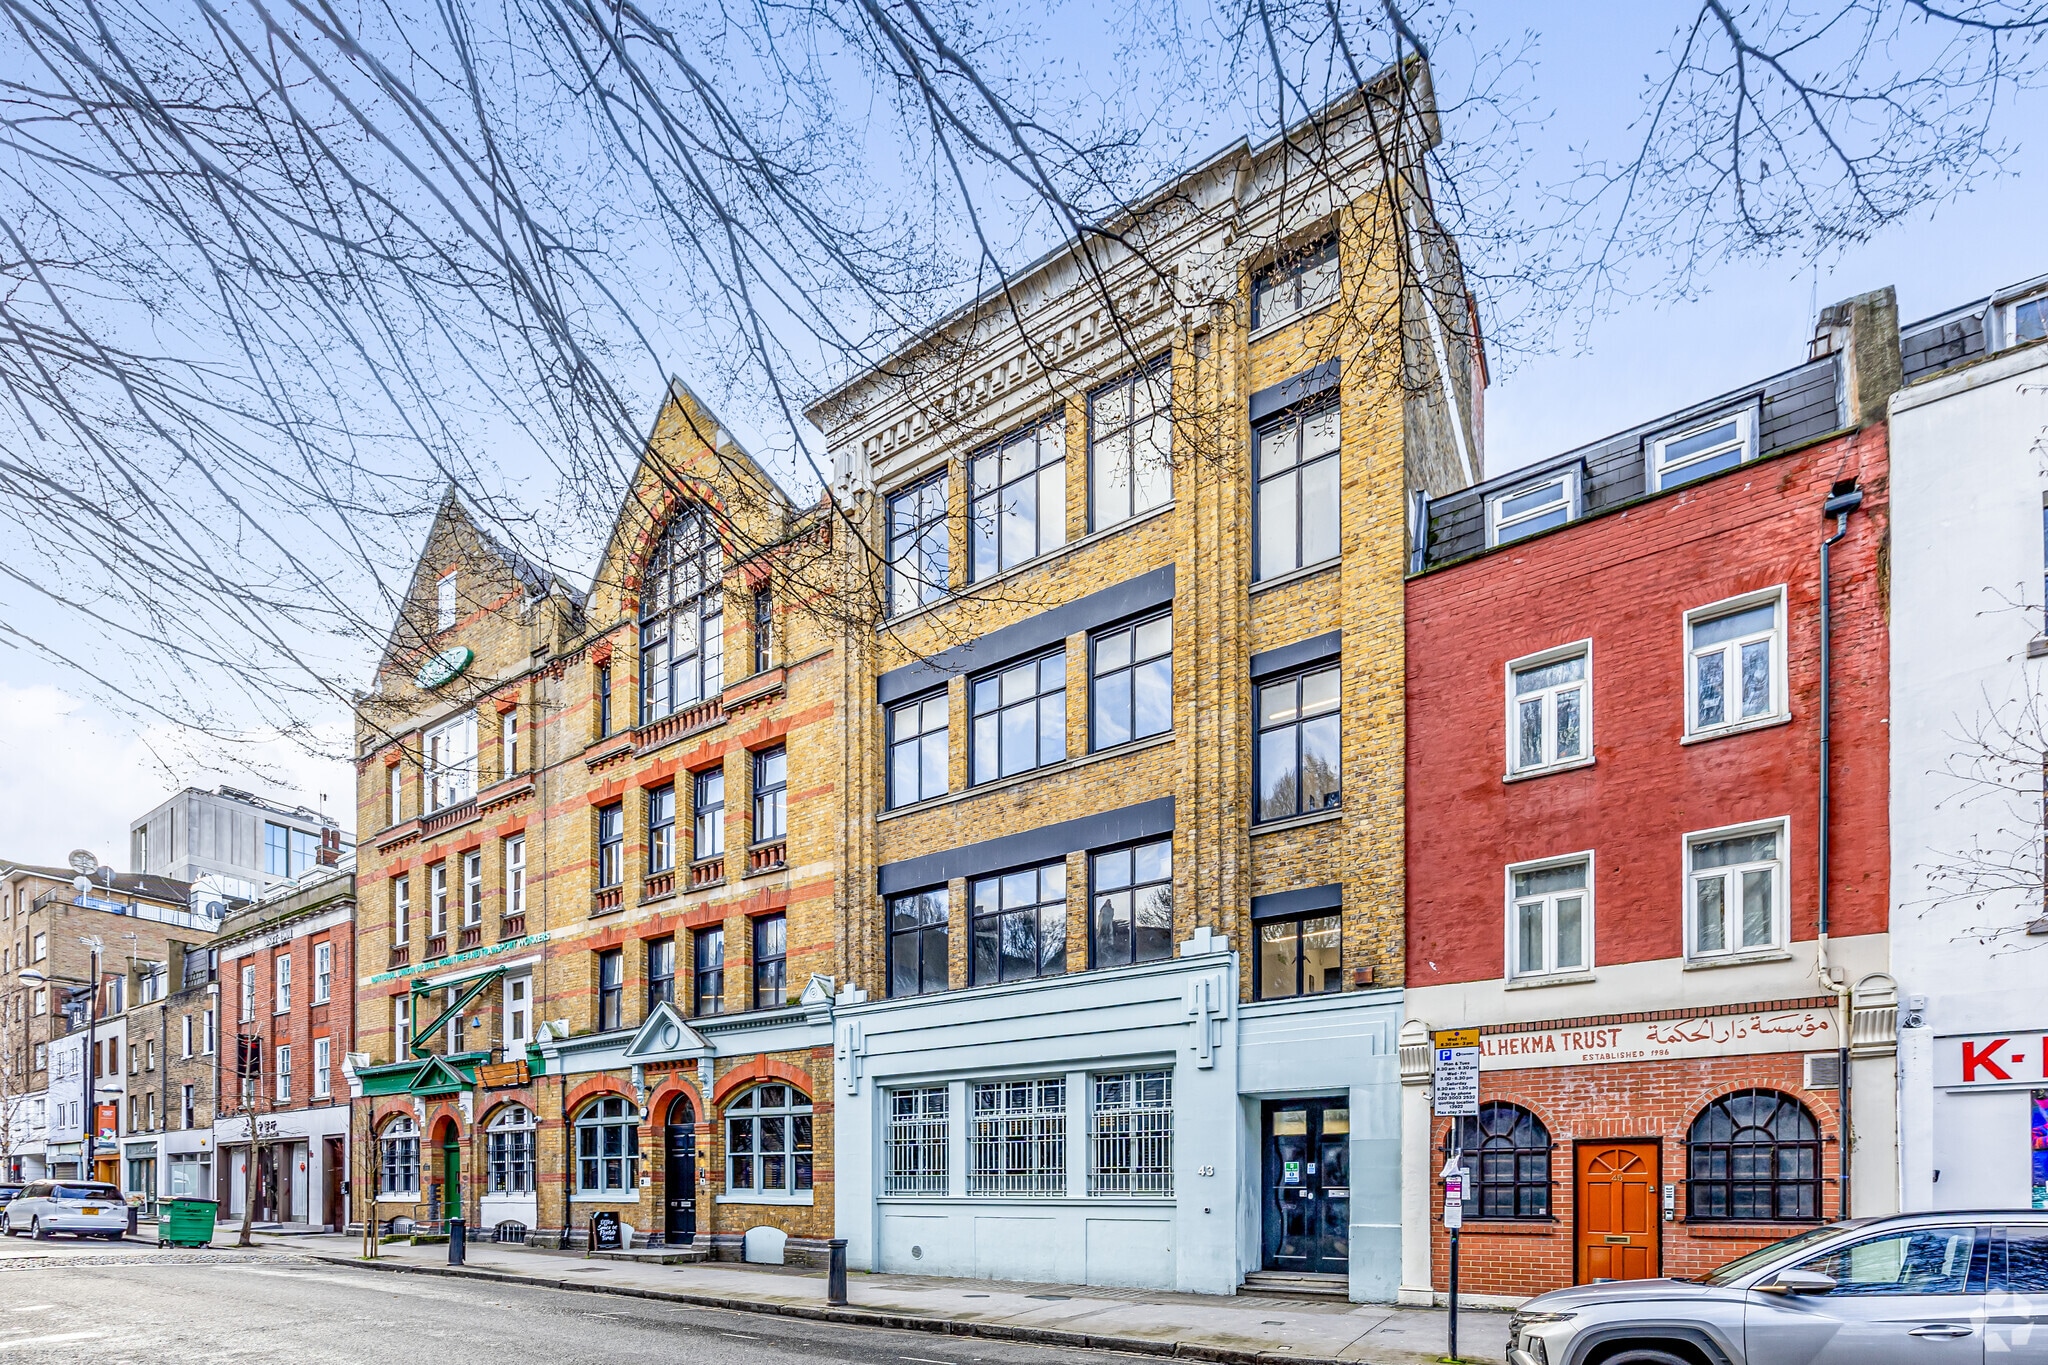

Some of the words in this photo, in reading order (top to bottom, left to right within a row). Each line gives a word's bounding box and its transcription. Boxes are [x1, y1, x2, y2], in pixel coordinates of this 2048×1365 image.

[482, 940, 517, 956] TRANSPORT
[517, 933, 550, 947] WORKERS
[1479, 1034, 1556, 1057] ALHEKMA
[1561, 1028, 1622, 1051] TRUST
[1582, 1050, 1645, 1061] ESTABLISHED
[1651, 1049, 1670, 1057] 1986
[1198, 1165, 1214, 1176] 43
